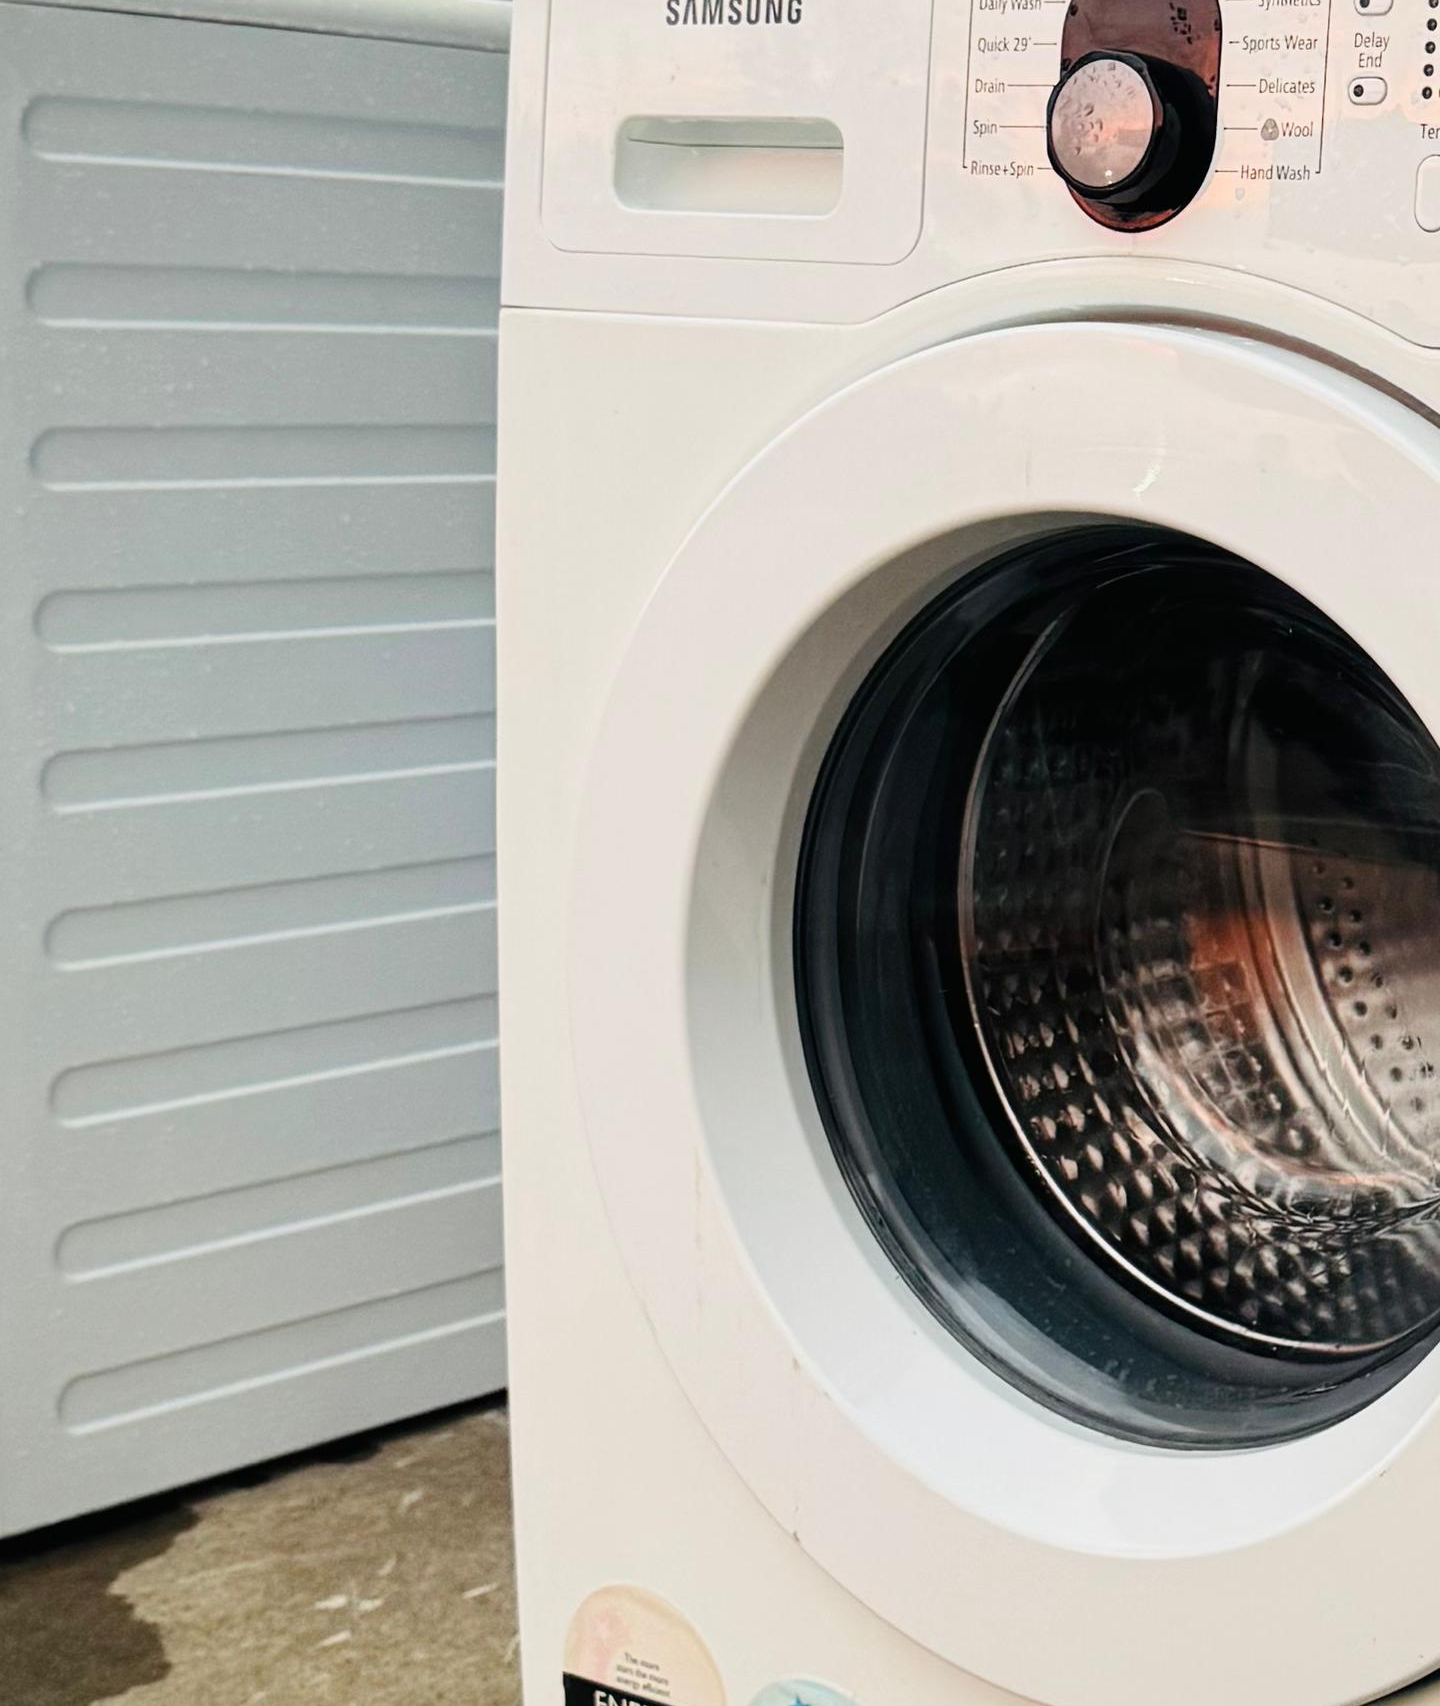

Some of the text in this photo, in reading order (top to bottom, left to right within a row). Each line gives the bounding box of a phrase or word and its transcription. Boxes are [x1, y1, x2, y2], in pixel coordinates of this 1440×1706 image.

[977, 37, 1010, 53] Quick
[1242, 35, 1319, 54] Sports Wear
[1354, 31, 1390, 52] Delay
[1358, 52, 1383, 68] End
[974, 79, 1006, 94] Drain
[1258, 78, 1316, 94] Delicates
[973, 120, 998, 138] Spin
[1281, 121, 1314, 138] Wool
[1240, 165, 1311, 181] Hand Wash
